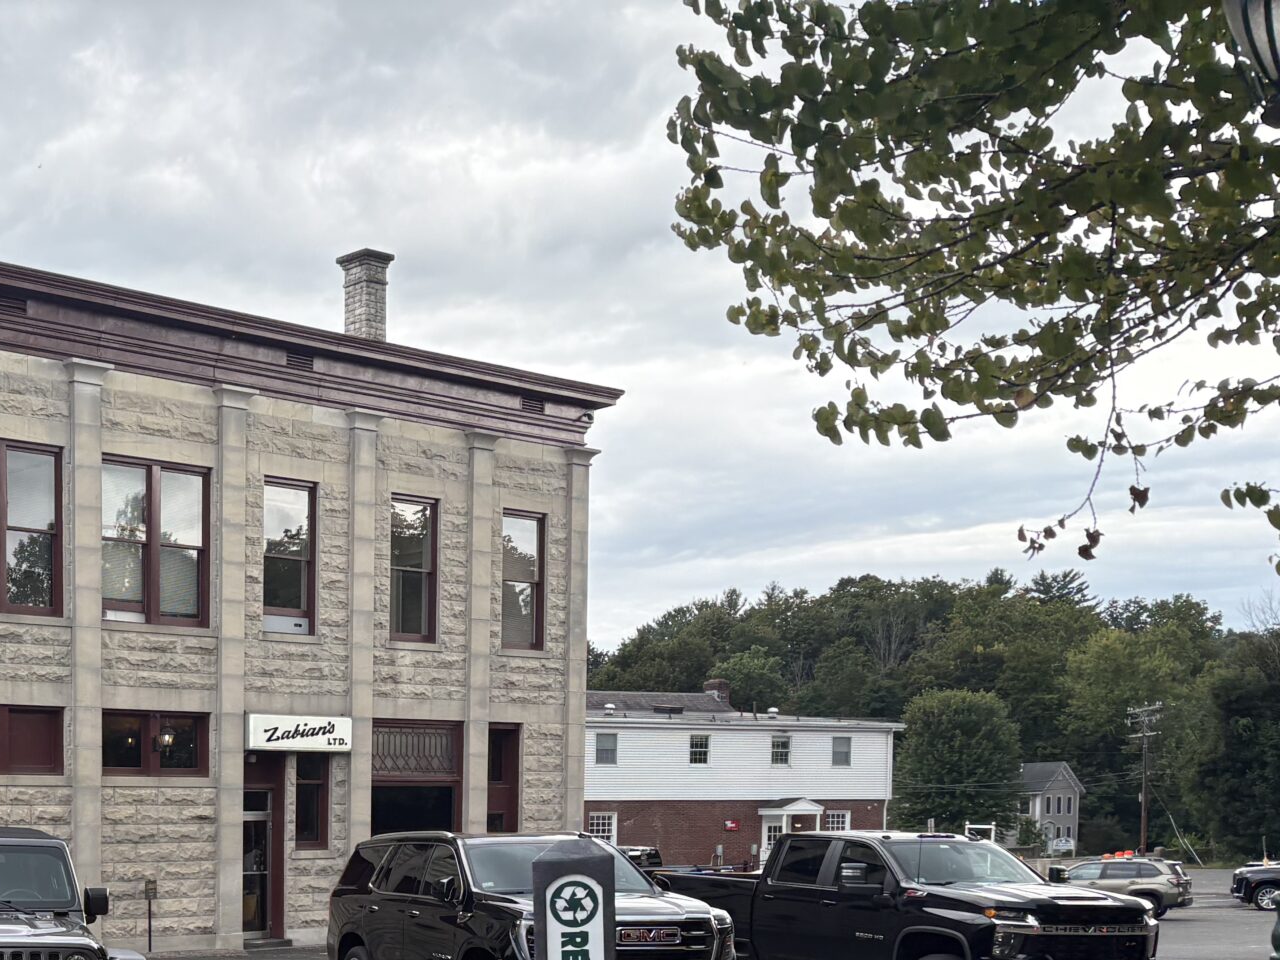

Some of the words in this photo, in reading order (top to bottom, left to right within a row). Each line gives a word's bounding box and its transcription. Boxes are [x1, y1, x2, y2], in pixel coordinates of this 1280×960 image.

[263, 721, 335, 743] Zabian's
[327, 738, 348, 746] LTD.
[1042, 926, 1144, 934] CHEVROLET
[621, 929, 678, 942] GMC
